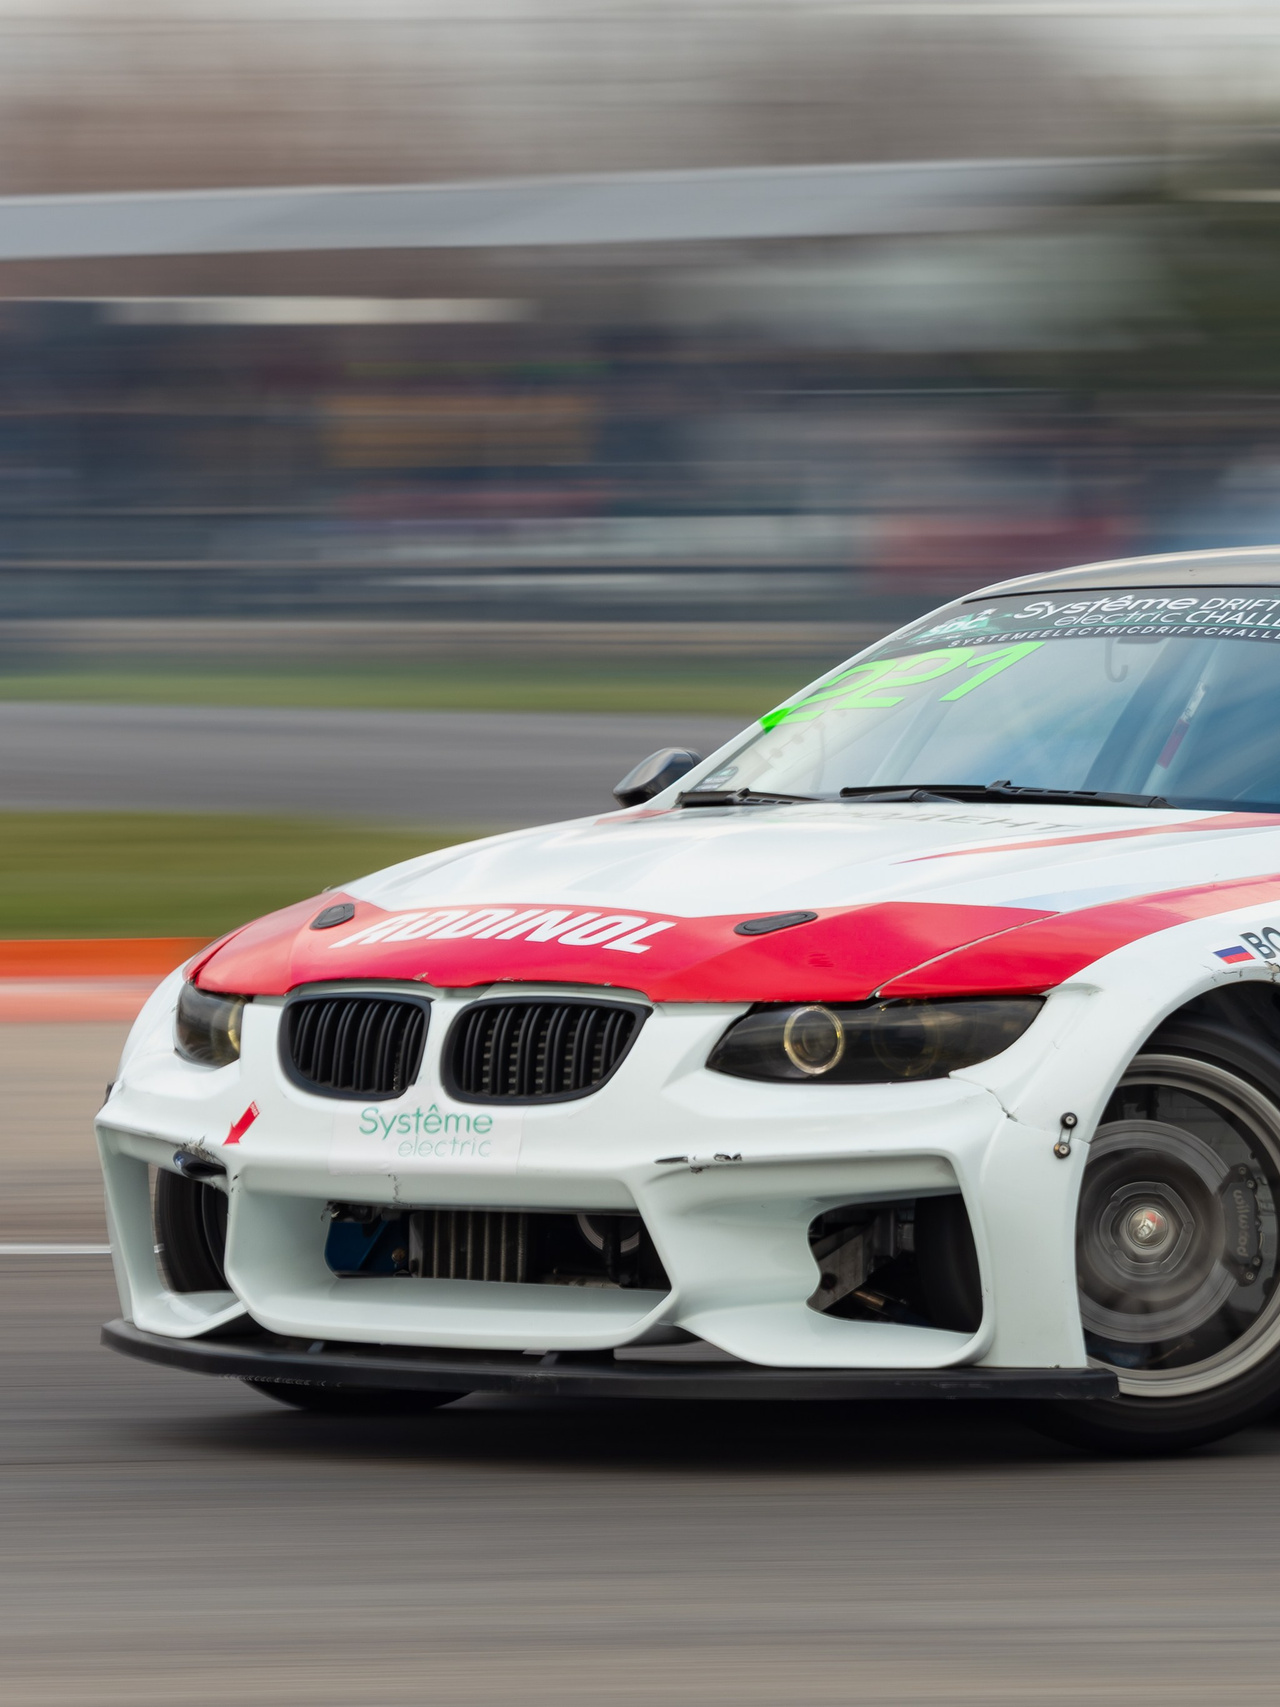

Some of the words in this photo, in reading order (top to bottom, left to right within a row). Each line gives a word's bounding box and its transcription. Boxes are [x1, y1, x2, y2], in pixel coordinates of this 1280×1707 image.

[1013, 594, 1199, 620] Systême
[1054, 609, 1184, 627] electric
[759, 641, 1046, 733] 221
[327, 908, 678, 954] ADDINOL
[359, 1104, 493, 1141] Systême
[397, 1137, 492, 1158] electric
